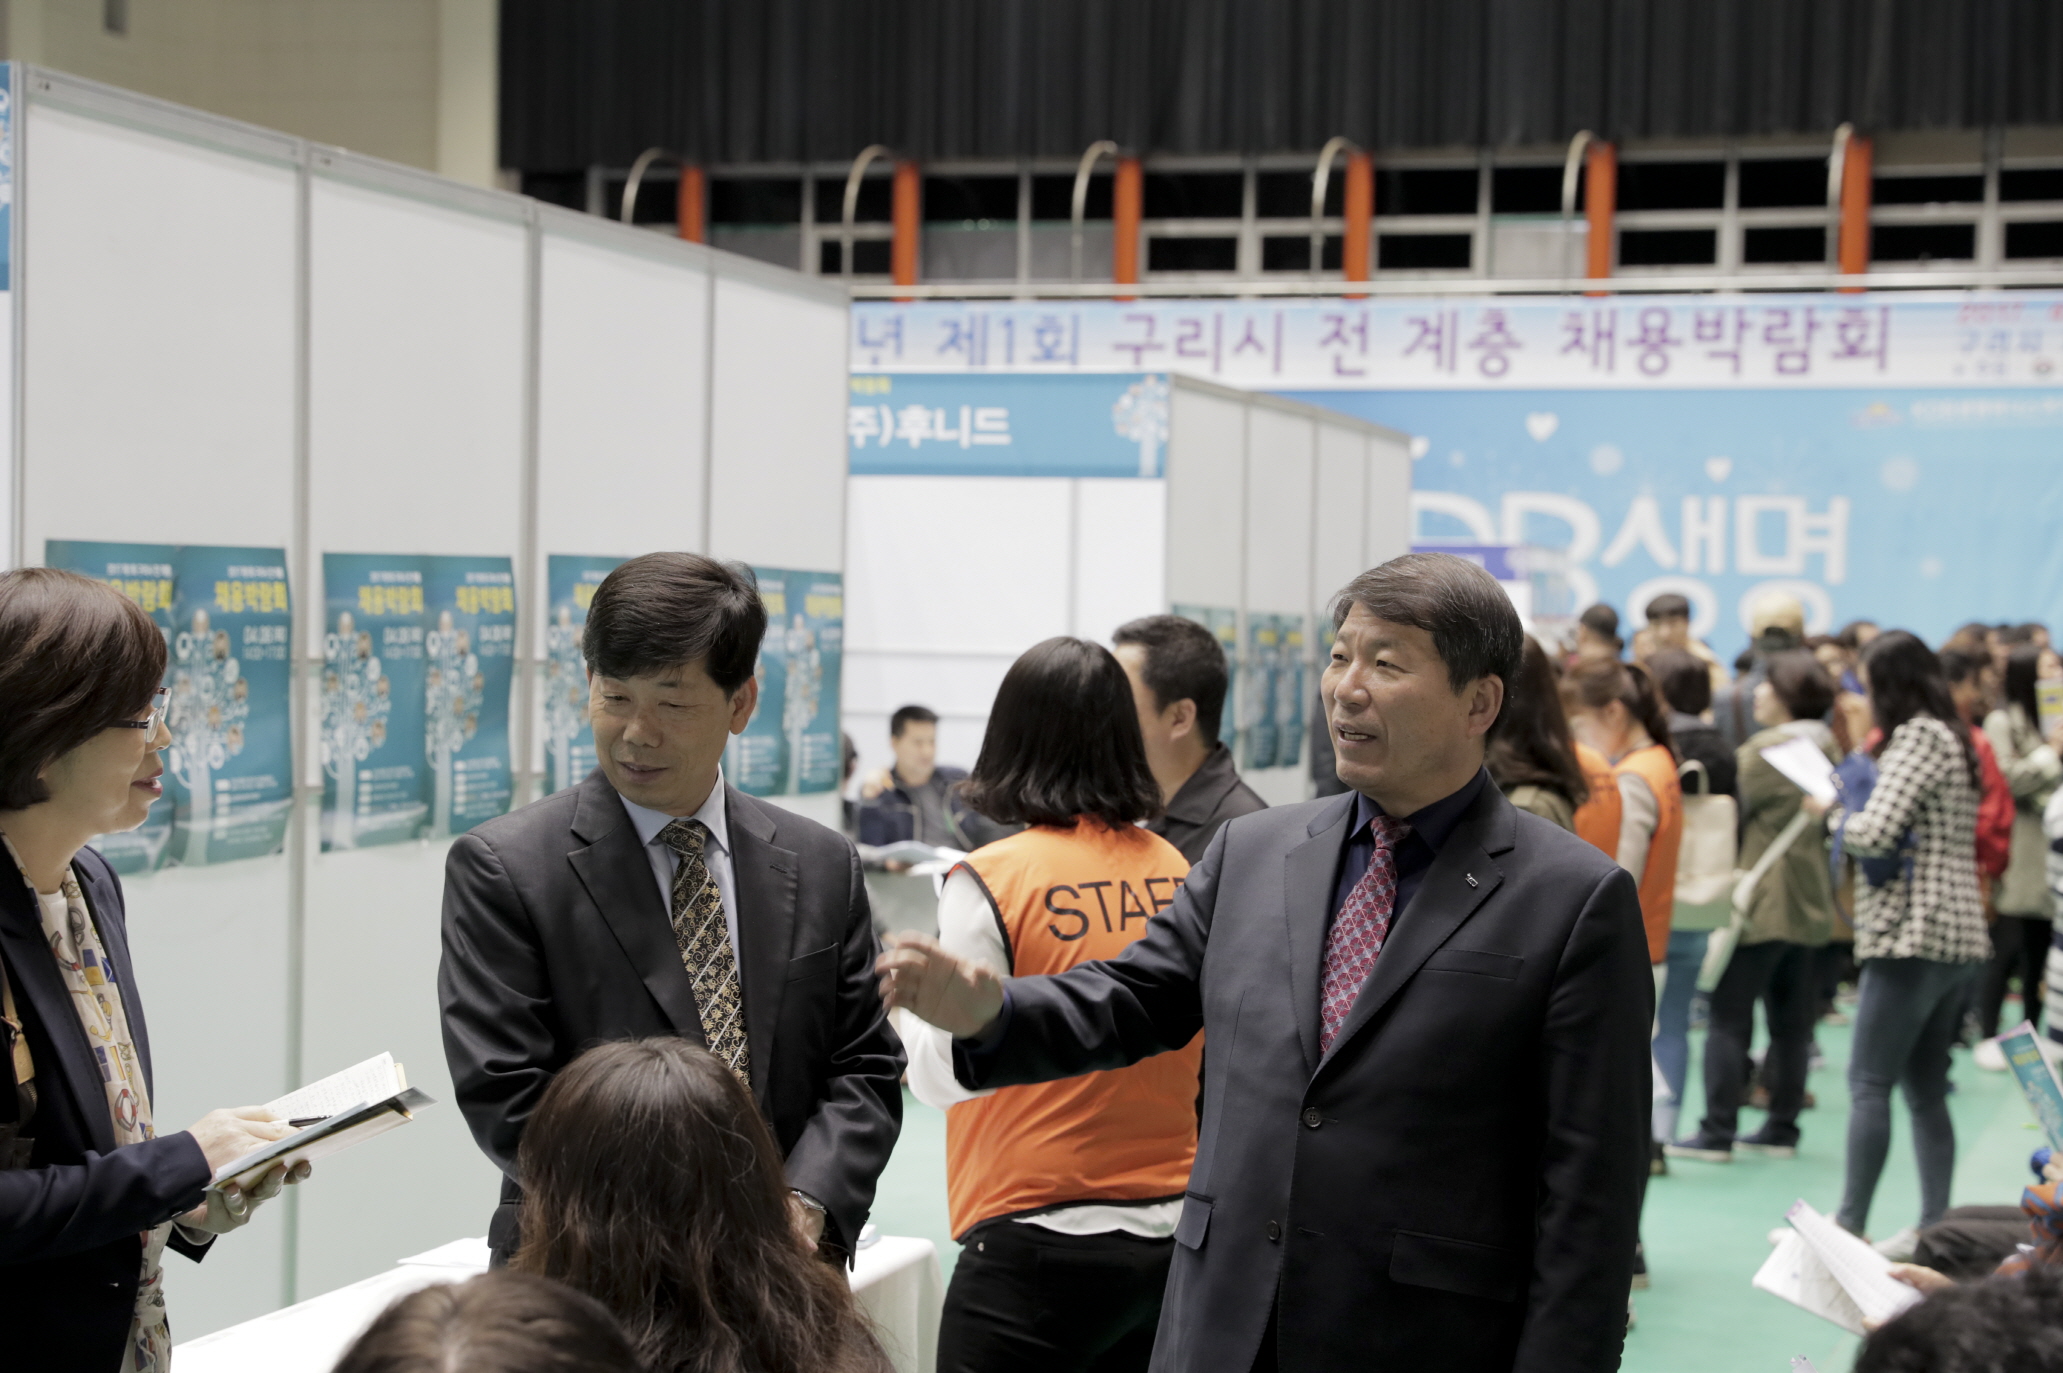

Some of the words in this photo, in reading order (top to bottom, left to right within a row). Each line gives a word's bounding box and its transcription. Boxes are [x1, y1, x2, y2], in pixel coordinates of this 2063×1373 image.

[936, 312, 1082, 368] 제1회
[1112, 311, 1287, 375] 구리시
[1320, 310, 1369, 377] 전
[1403, 309, 1522, 379] 계층
[1561, 306, 1892, 377] 채용박람회
